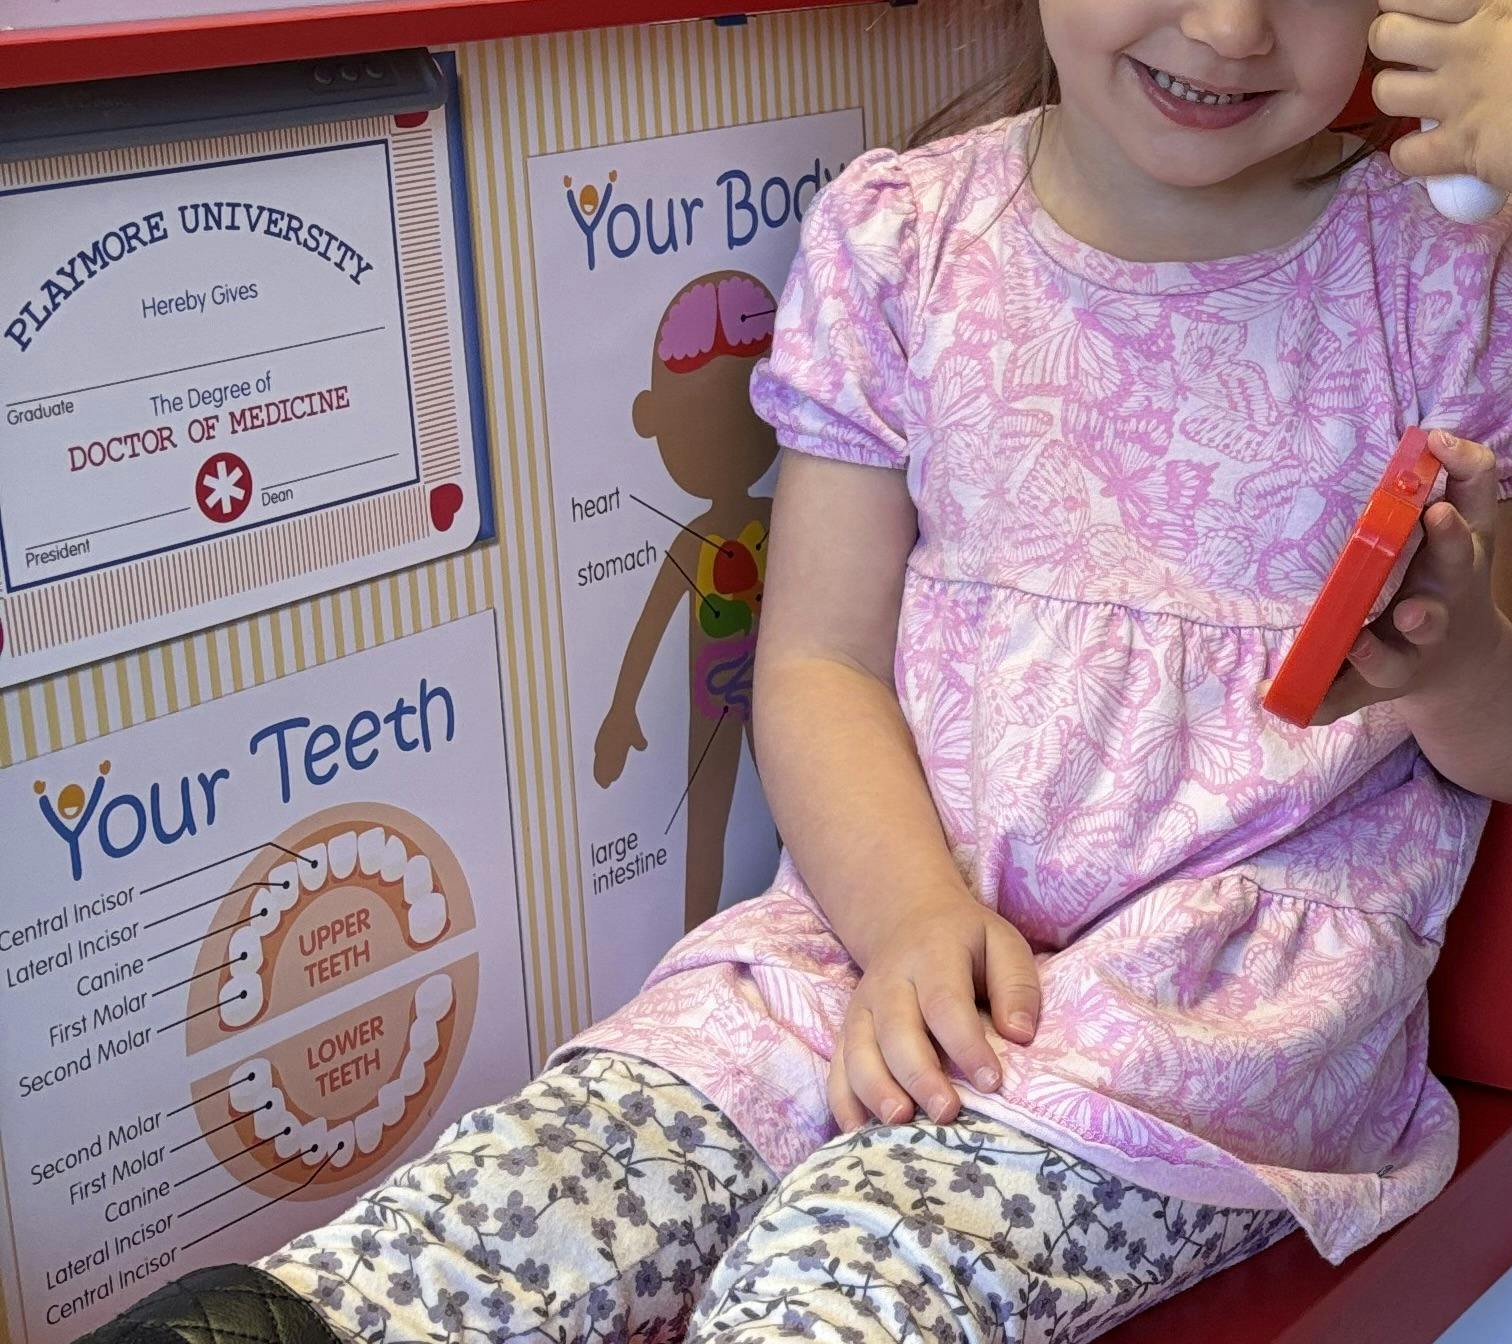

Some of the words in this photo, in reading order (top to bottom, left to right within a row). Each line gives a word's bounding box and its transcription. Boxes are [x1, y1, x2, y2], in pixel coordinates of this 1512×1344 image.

[565, 183, 704, 271] Your
[718, 158, 846, 253] Bod
[4, 211, 169, 352] PLAYMORE
[180, 202, 374, 286] UNIVERSITY
[142, 289, 207, 319] Hereby
[211, 281, 259, 306] Gives
[6, 398, 75, 426] Graduate
[150, 391, 184, 417] The
[188, 378, 253, 413] Degree
[256, 371, 273, 394] of
[68, 428, 177, 472] DOCTOR
[188, 415, 219, 442] OF
[230, 386, 351, 435] MEDICINE
[261, 487, 294, 507] Dean
[571, 486, 622, 523] heart
[25, 538, 91, 568] President
[576, 542, 657, 589] stomach
[38, 768, 230, 881] Your
[249, 677, 455, 804] Teeth
[590, 829, 640, 872] large
[591, 843, 669, 897] intestine
[0, 906, 67, 952] Central
[74, 886, 134, 924] Incisor
[298, 907, 372, 957] UPPER
[7, 943, 72, 988] Lateral
[79, 922, 139, 960] Incisor
[77, 958, 144, 996] Canine
[304, 939, 371, 989] TEETH
[49, 1017, 86, 1047] First
[93, 992, 147, 1030] Molar
[306, 1014, 385, 1071] LOWER
[19, 1048, 91, 1098] Second
[98, 1026, 152, 1065] Molar
[315, 1047, 382, 1098] TEETH
[31, 1135, 102, 1186] Second
[108, 1112, 162, 1151] Molar
[69, 1174, 107, 1205] First
[112, 1145, 166, 1186] Molar
[105, 1180, 171, 1223] Canine
[46, 1241, 109, 1291] Lateral
[115, 1214, 173, 1256] Incisor
[46, 1276, 114, 1326] Central
[119, 1245, 178, 1290] Incisor
